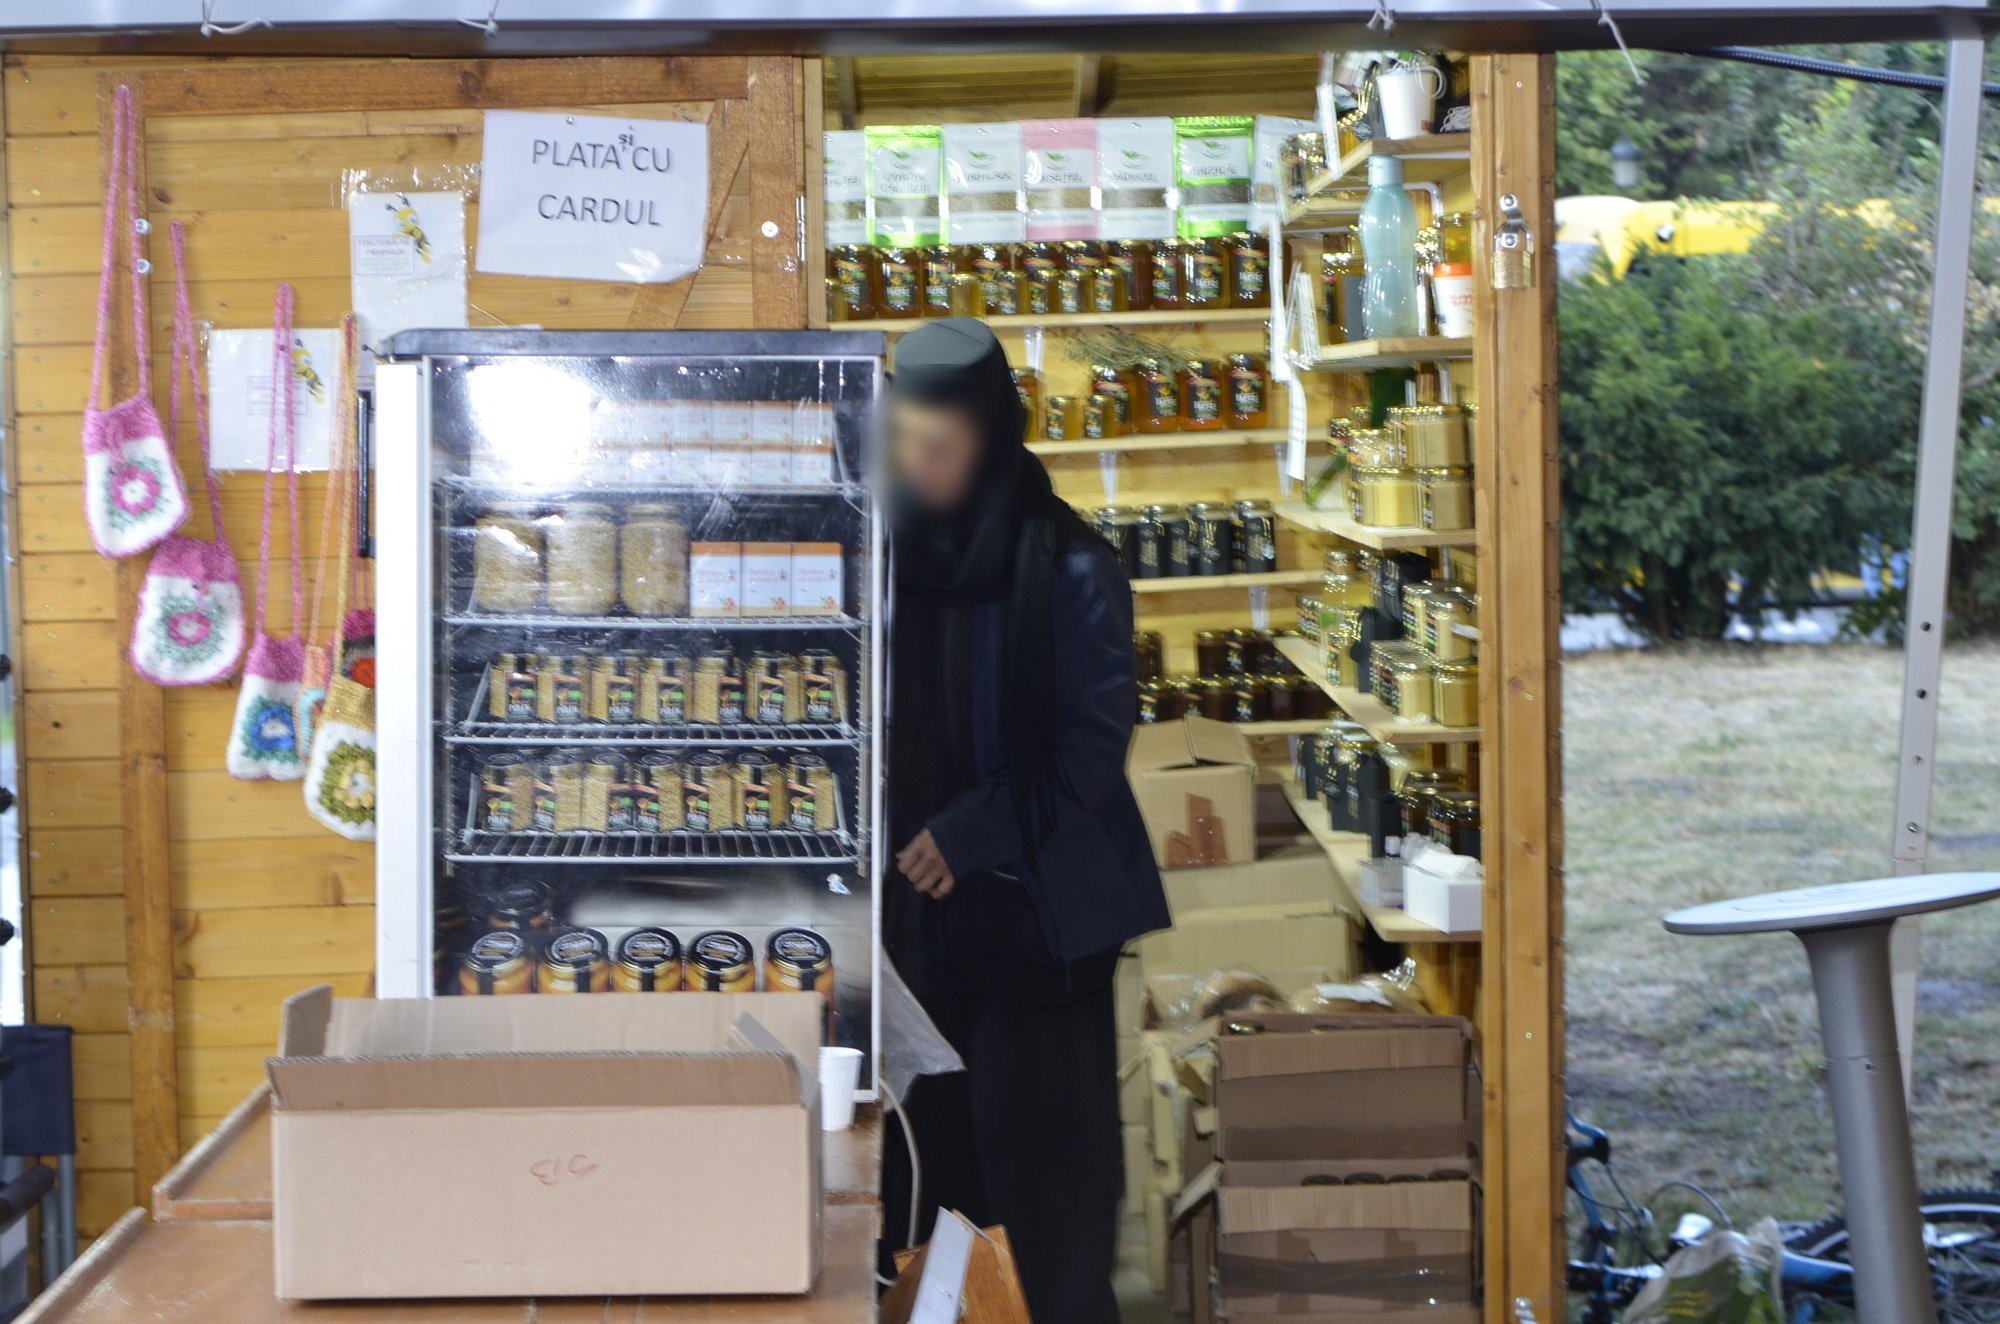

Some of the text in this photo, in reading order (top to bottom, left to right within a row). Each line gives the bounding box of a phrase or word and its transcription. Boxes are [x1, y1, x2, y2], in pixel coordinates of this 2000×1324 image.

[532, 138, 621, 170] PLATA
[631, 146, 673, 173] CU
[537, 193, 662, 226] CARDUL
